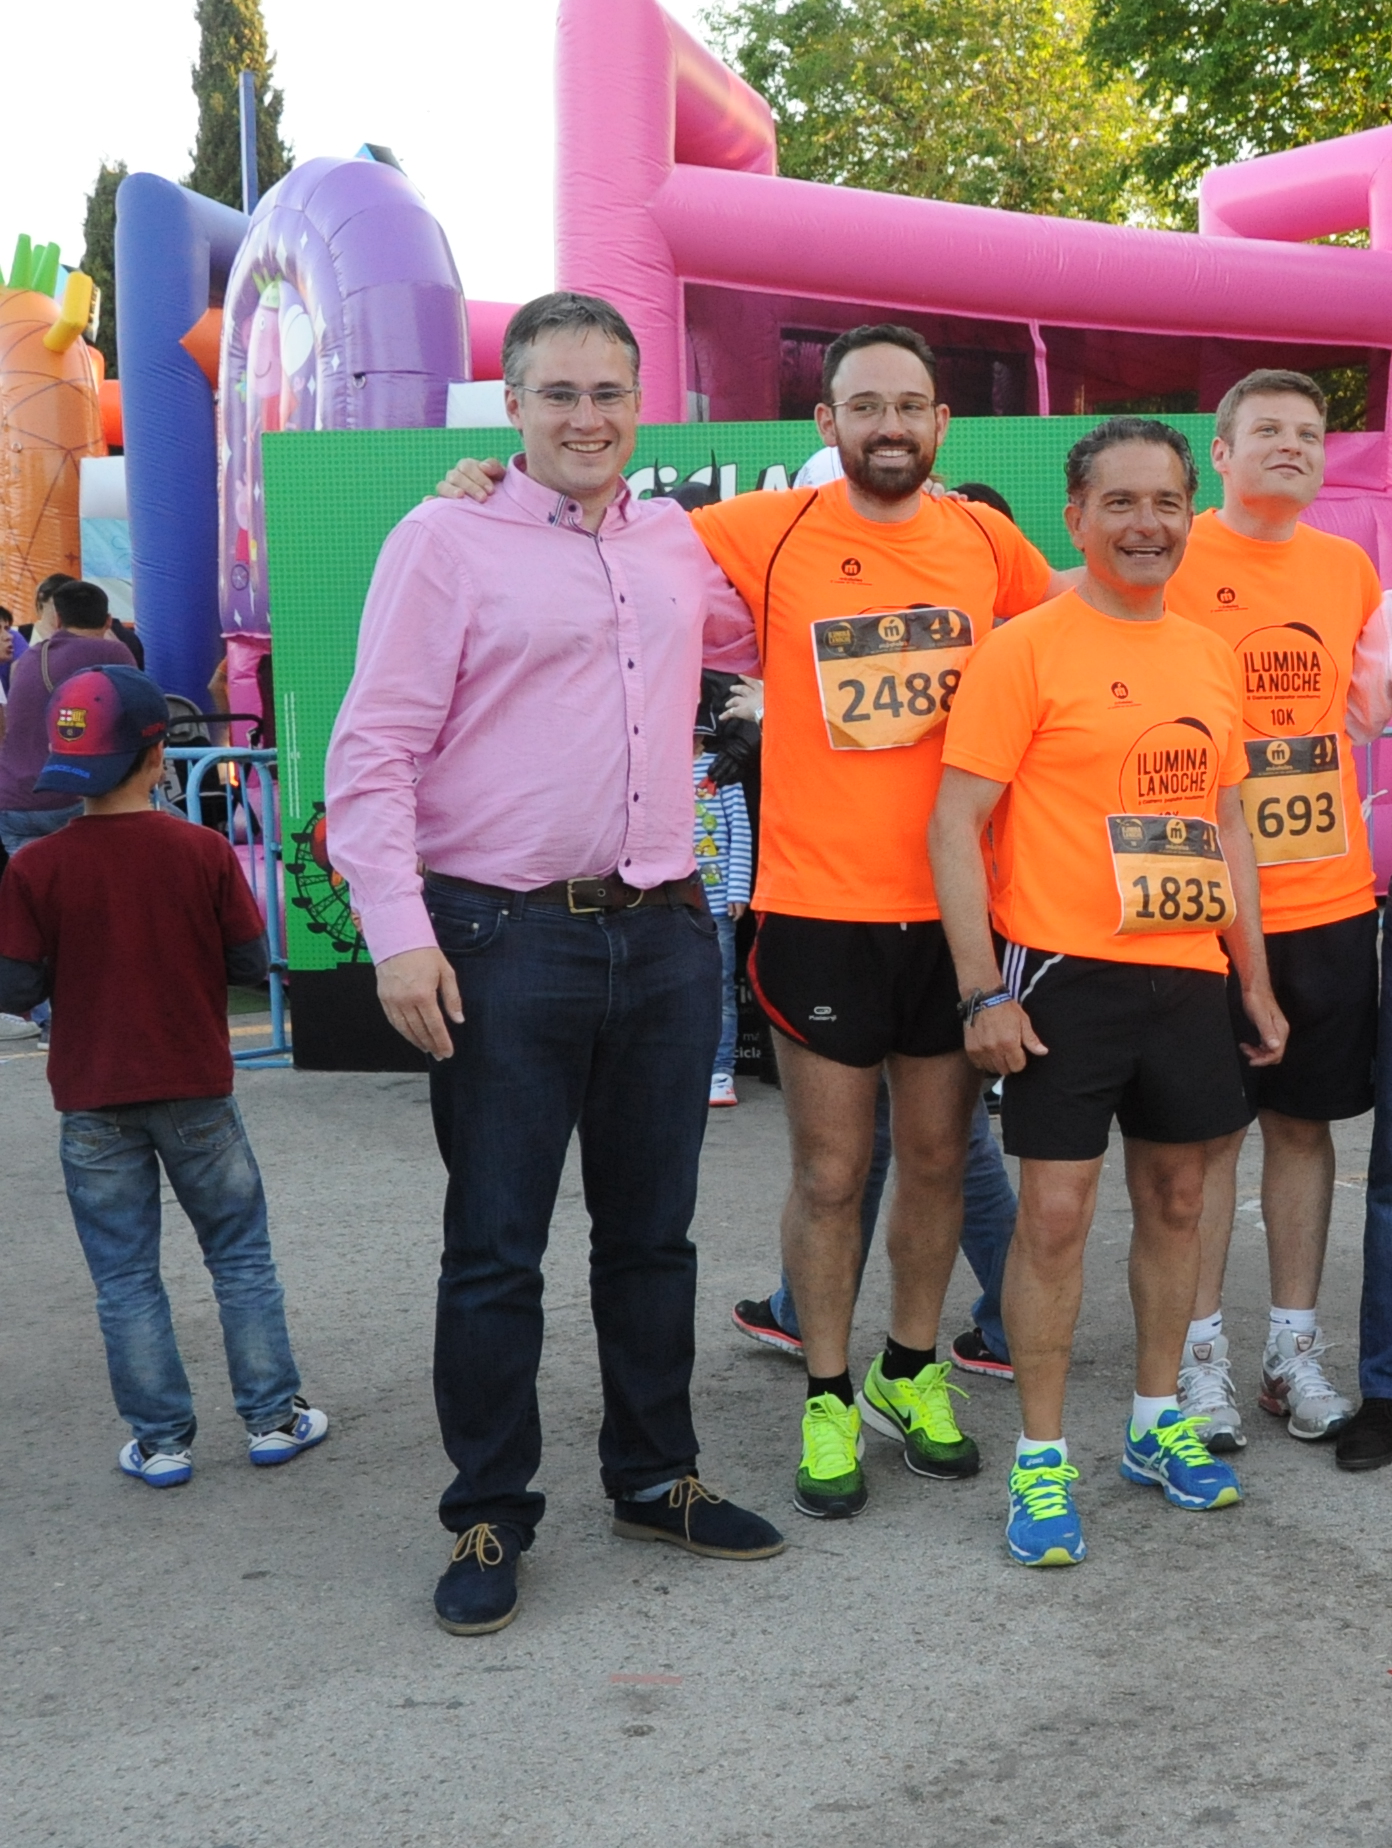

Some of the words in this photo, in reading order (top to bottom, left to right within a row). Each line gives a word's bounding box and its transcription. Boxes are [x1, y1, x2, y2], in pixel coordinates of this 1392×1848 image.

[1243, 651, 1322, 673] ILUMINA
[838, 669, 962, 723] 2488
[1270, 708, 1296, 726] 10K
[1137, 748, 1208, 776] ILUMINA
[1241, 791, 1337, 839] 693
[1132, 875, 1226, 923] 1835
